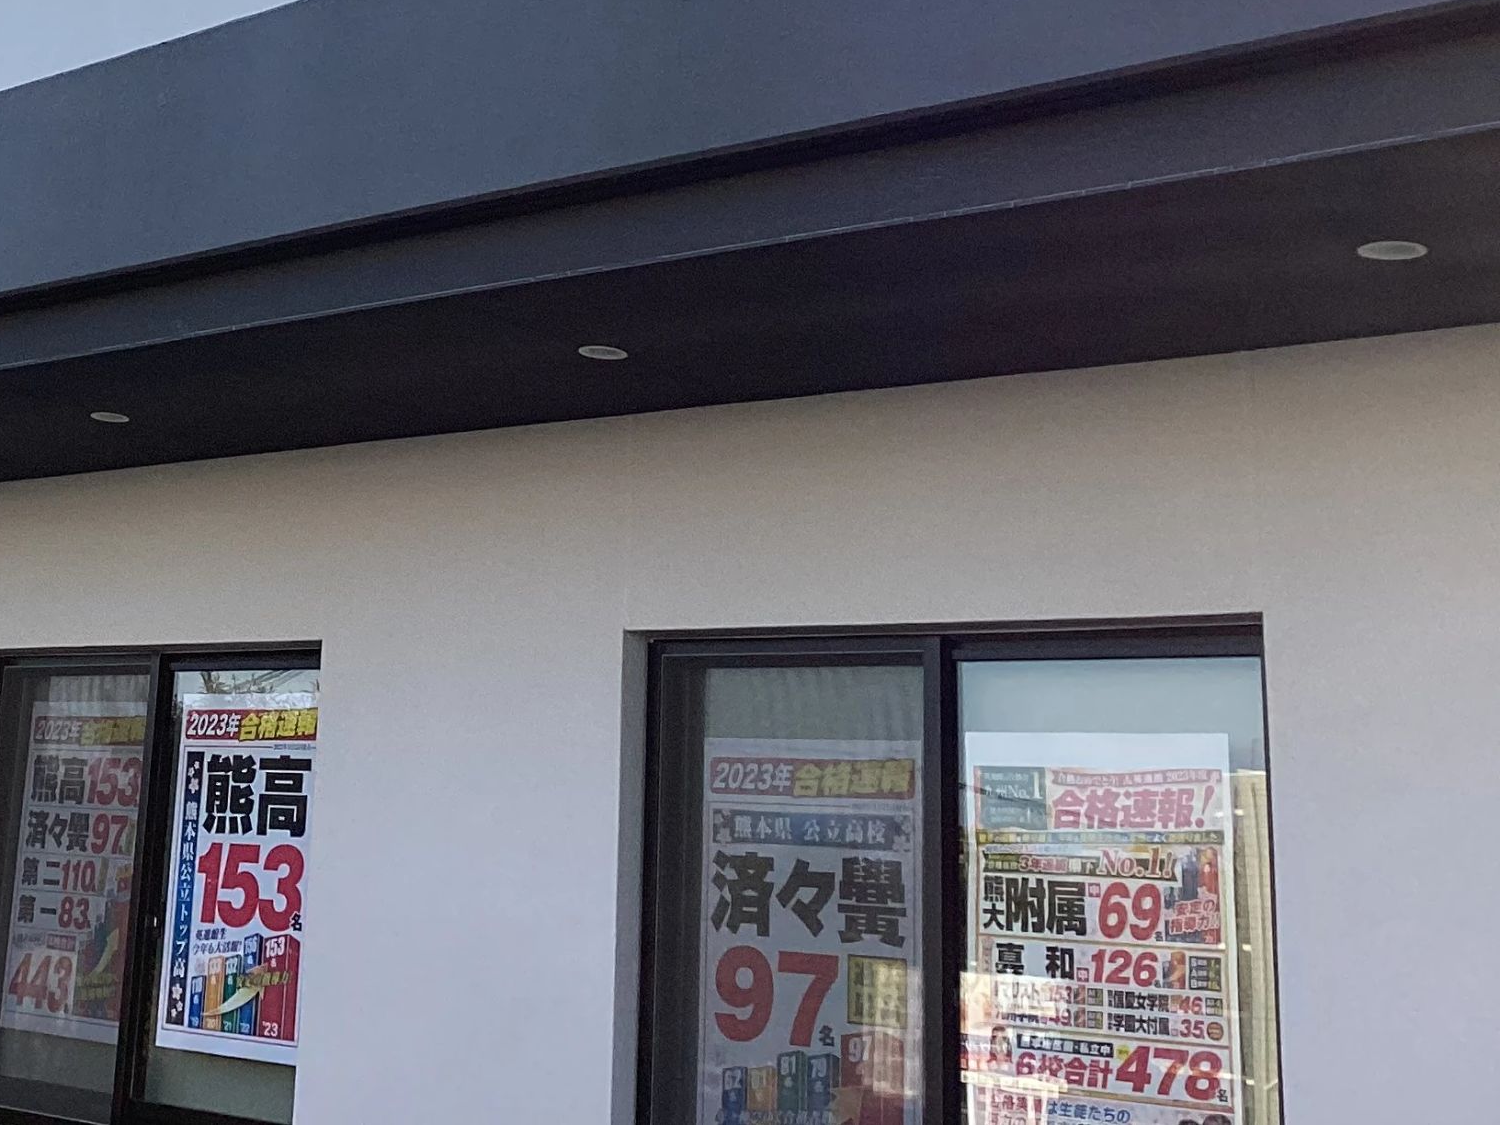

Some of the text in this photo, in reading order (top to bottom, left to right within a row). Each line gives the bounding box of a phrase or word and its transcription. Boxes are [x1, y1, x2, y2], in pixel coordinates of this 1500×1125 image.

[31, 754, 88, 805] 熊高
[202, 754, 312, 838] 熊高
[1051, 785, 1215, 829] 合格速報!
[25, 810, 90, 852] 済々黌
[735, 816, 886, 844] 熊本県 公立高校
[21, 857, 60, 886] 第二
[173, 801, 198, 978] 熊本県公立トップ高
[17, 895, 57, 923] 第一
[710, 850, 907, 948] 済々黌
[1005, 877, 1088, 936] 附属
[1015, 1051, 1113, 1090] 6校合計
